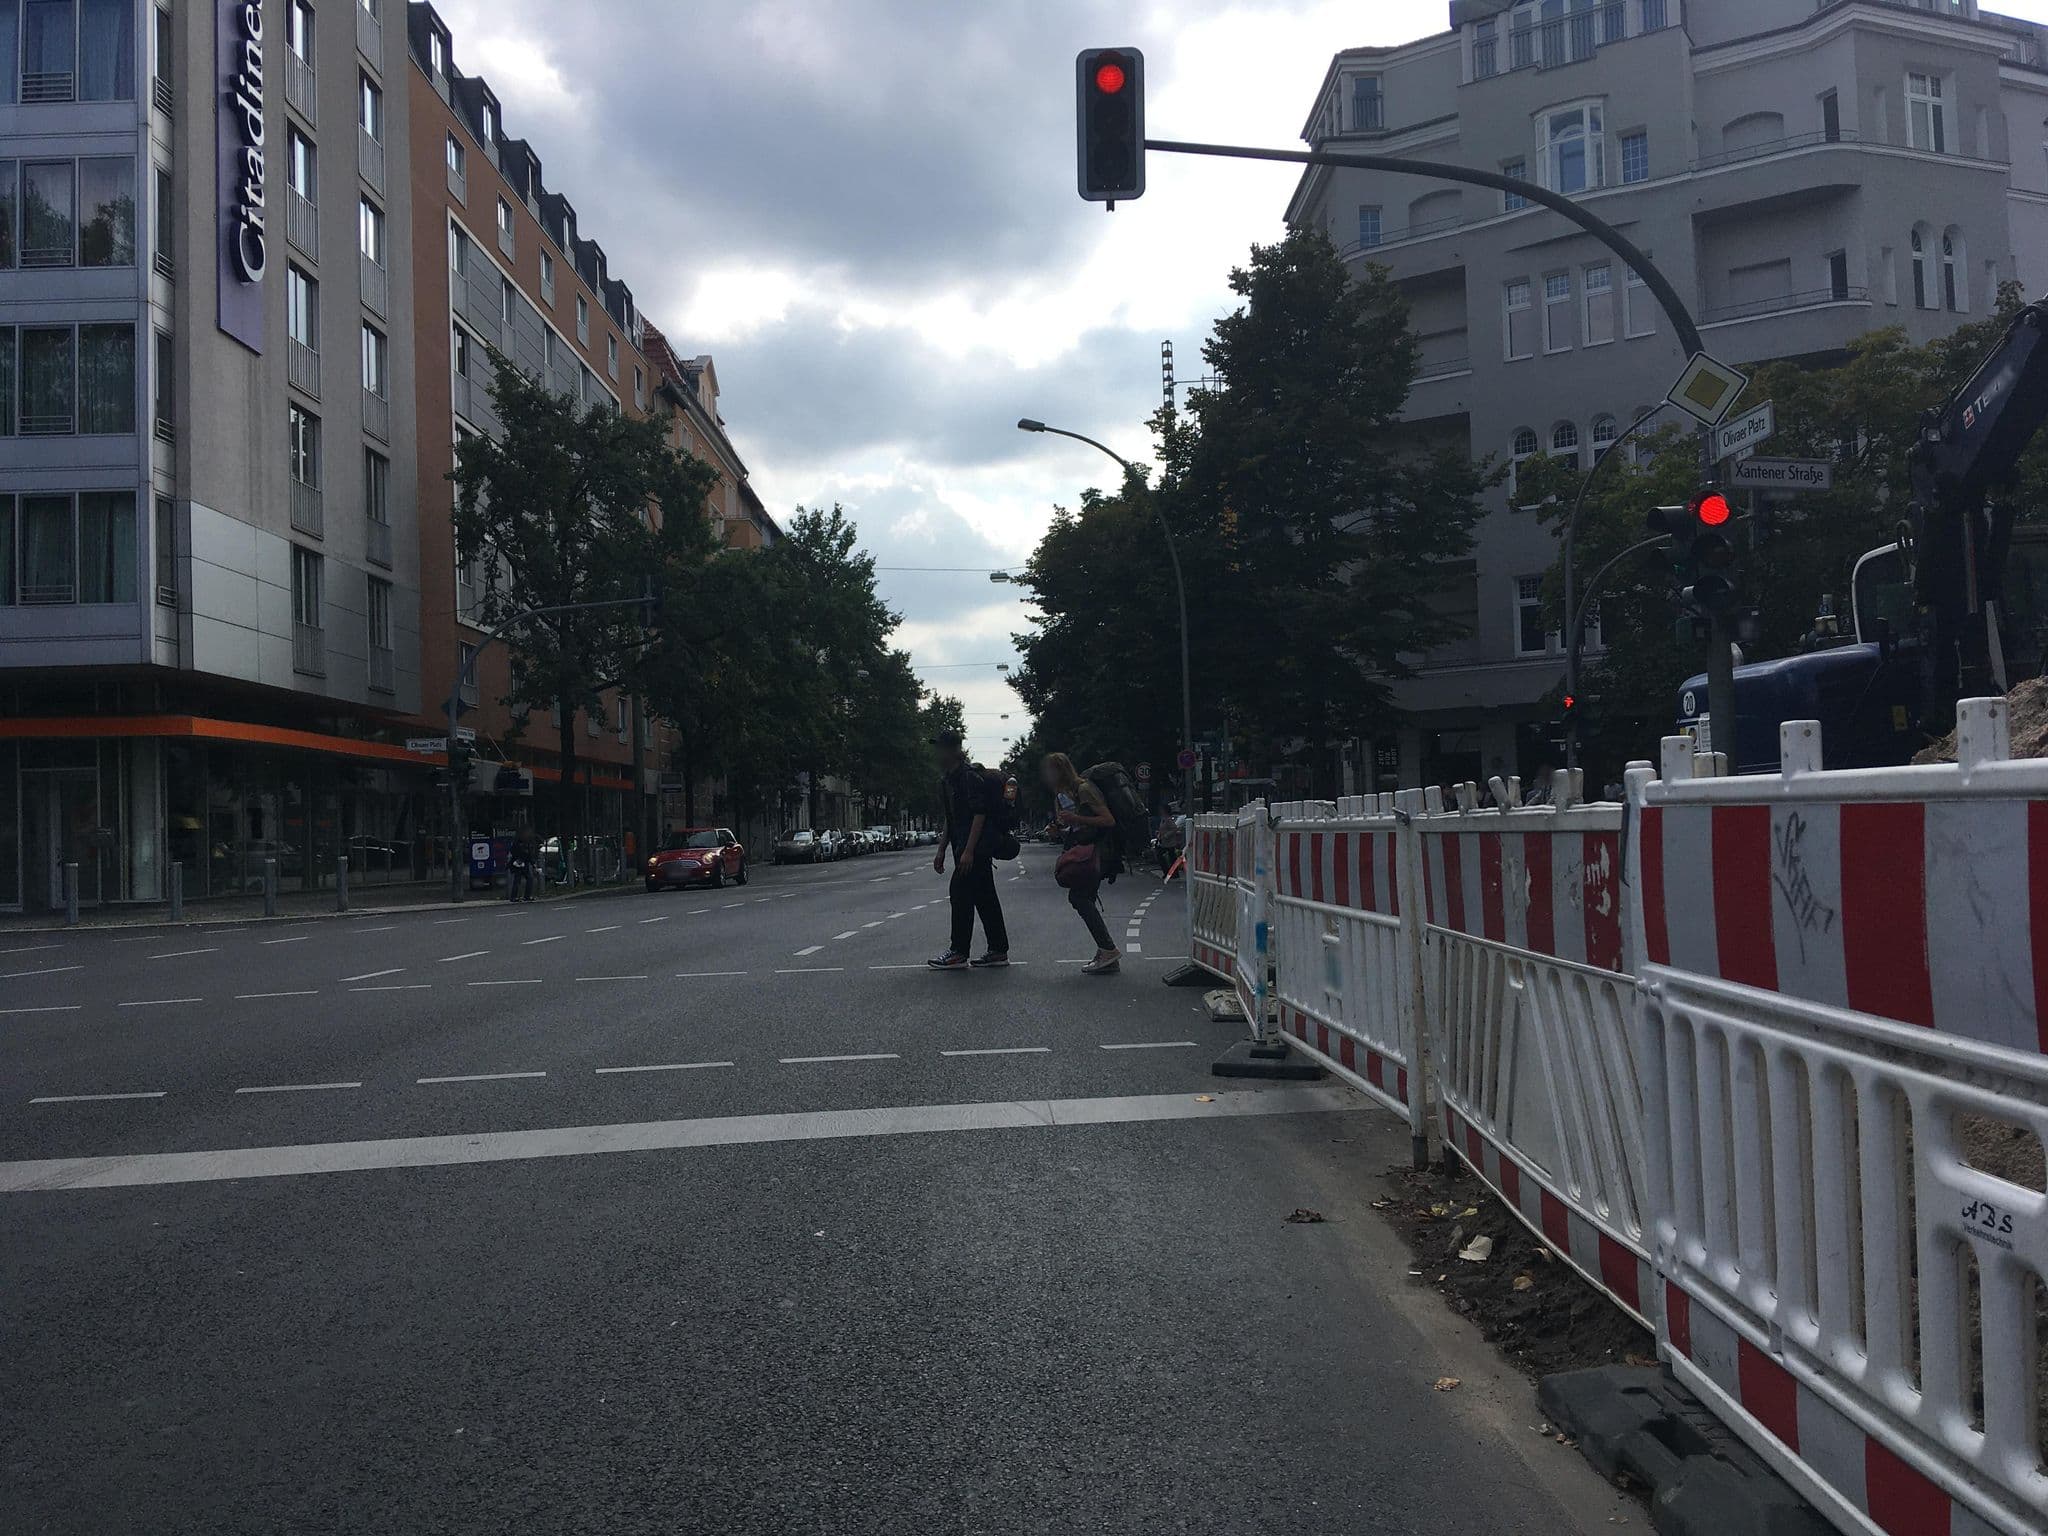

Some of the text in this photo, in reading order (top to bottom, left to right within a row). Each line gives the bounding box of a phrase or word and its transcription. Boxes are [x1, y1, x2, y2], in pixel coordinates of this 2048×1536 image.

[236, 0, 266, 283] Citadine
[1723, 417, 1766, 448] Olivaer Platz
[1736, 463, 1824, 485] Xantener Straße
[1685, 695, 1694, 712] 20
[1139, 767, 1150, 777] 30
[1961, 1200, 2013, 1233] ABS
